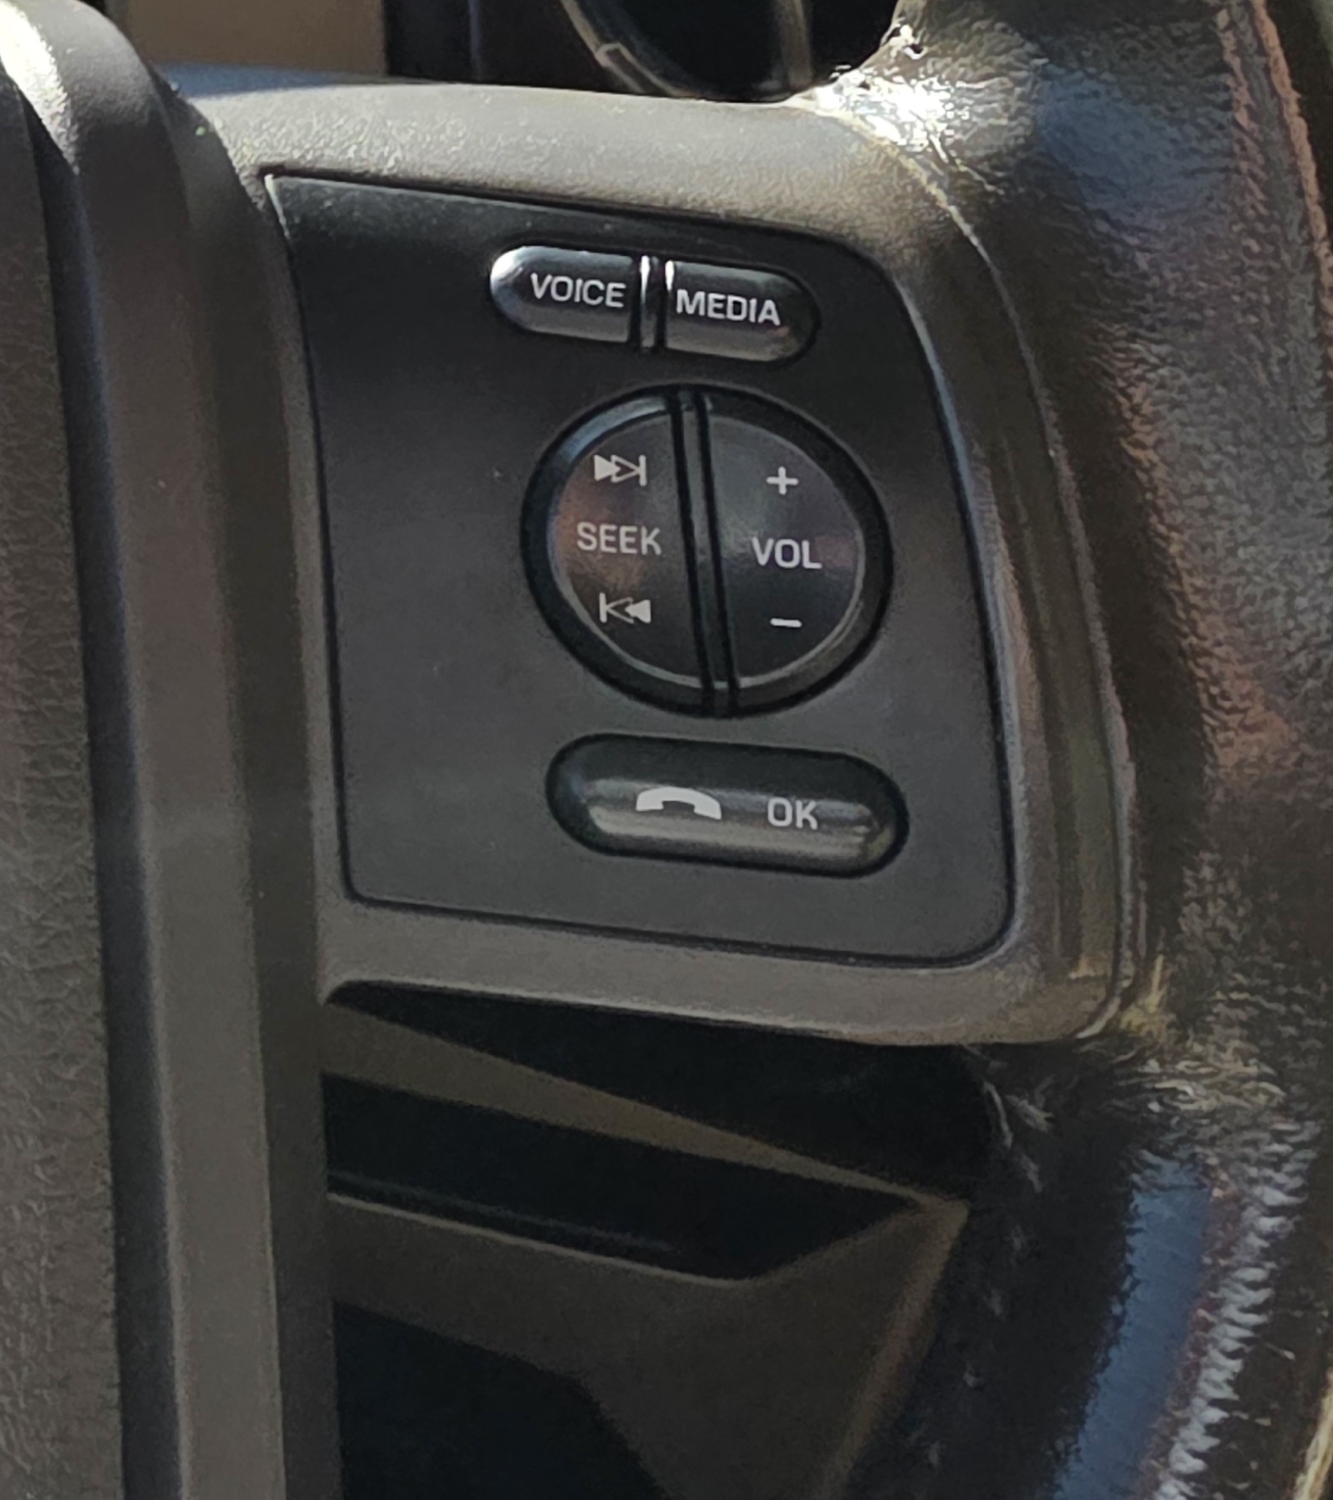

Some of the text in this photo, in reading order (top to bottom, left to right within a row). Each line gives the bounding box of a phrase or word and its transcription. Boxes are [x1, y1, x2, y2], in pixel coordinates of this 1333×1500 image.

[530, 271, 627, 309] VOICE
[675, 288, 782, 327] MEDIA
[575, 521, 663, 557] SEEK
[751, 536, 823, 571] VOL
[766, 797, 820, 831] OK
